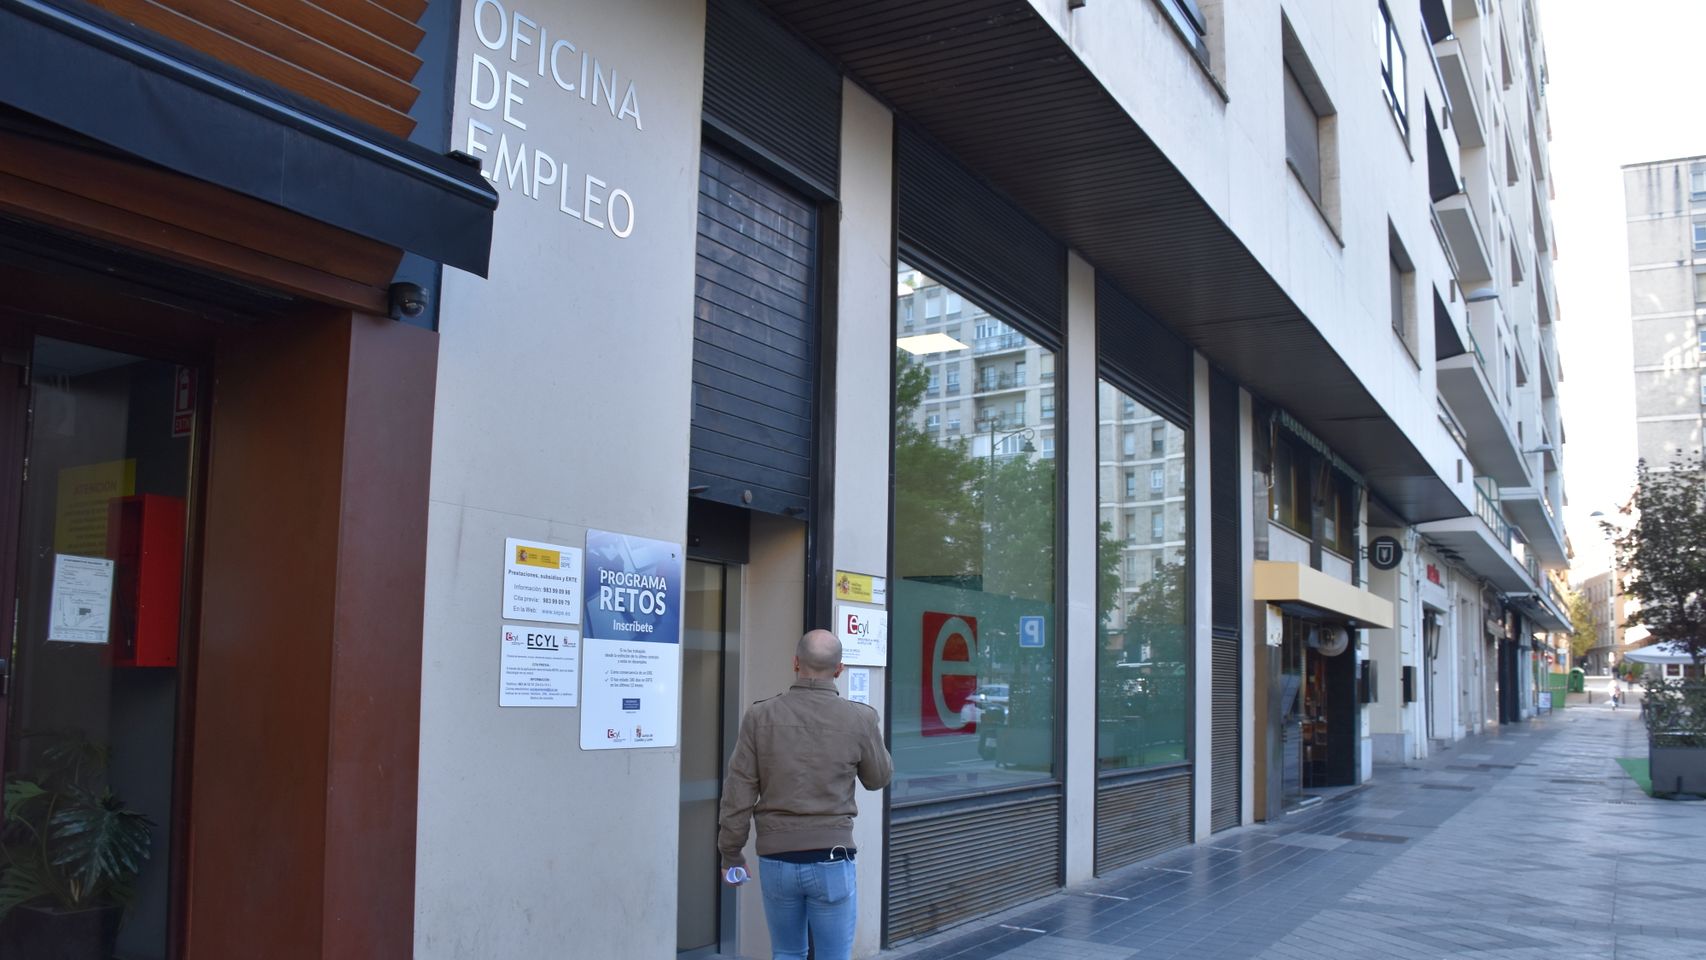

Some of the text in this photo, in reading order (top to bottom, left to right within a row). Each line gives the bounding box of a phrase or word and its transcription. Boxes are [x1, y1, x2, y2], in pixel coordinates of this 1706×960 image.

[470, 53, 529, 130] DE
[473, 0, 642, 130] OFICINA
[466, 117, 635, 238] EMPLEO
[600, 569, 667, 591] PROGRAMA
[600, 585, 666, 616] RETOS
[527, 633, 559, 648] ECYL
